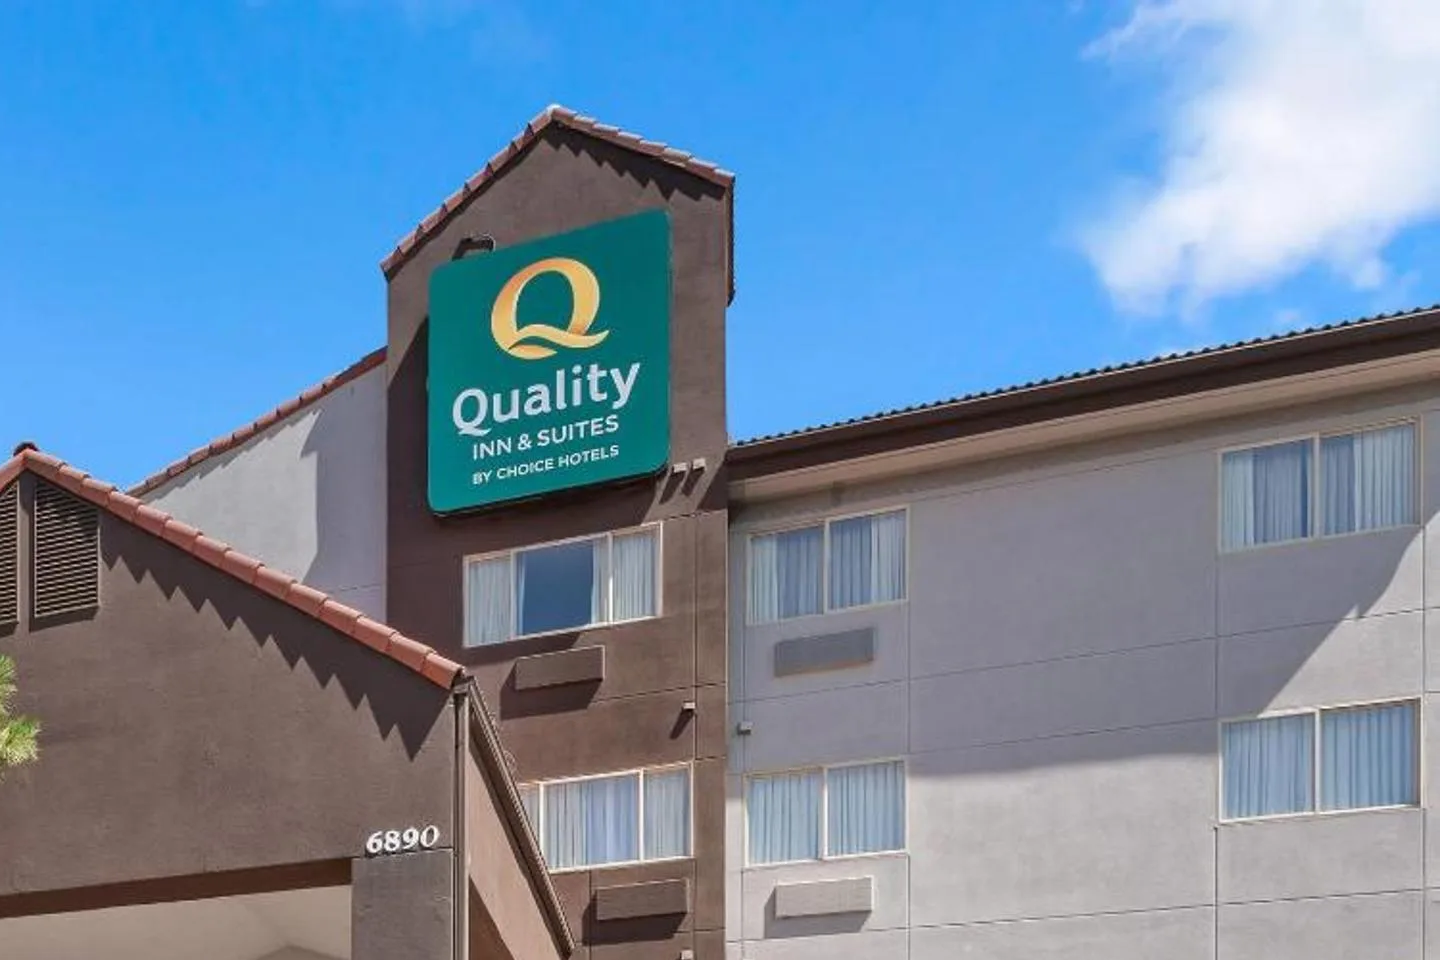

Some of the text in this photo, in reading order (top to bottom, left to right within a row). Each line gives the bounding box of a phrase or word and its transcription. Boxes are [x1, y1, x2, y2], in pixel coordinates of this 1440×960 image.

[491, 256, 609, 360] Q
[452, 362, 640, 436] Quality
[473, 414, 619, 460] INN & SUITES
[473, 445, 619, 485] BY CHOICE HOTELS
[366, 825, 440, 853] 6890
